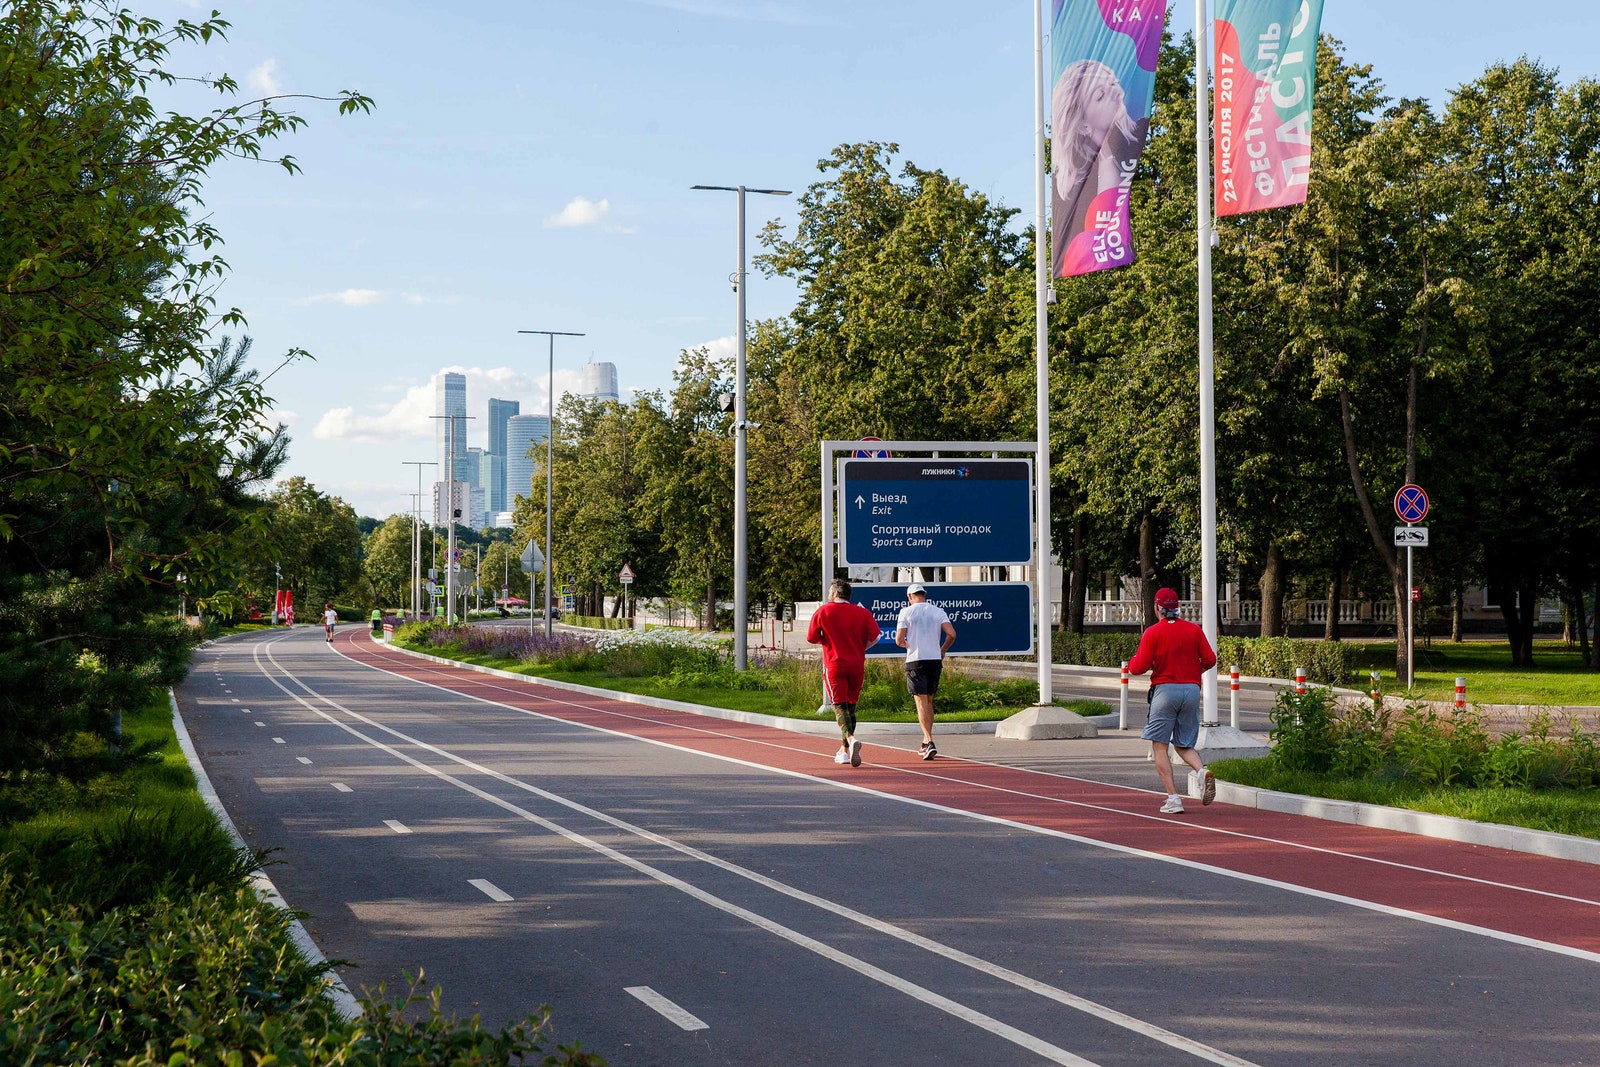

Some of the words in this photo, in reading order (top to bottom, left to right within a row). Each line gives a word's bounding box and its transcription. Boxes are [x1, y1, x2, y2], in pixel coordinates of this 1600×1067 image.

[1221, 53, 1235, 102] 2017
[1245, 22, 1281, 196] ФЕСТИВАЛЬ
[1221, 107, 1232, 174] ИЮЛЯ
[1223, 178, 1237, 203] 22
[872, 493, 908, 505] Выезд
[871, 506, 892, 515] Exit
[871, 524, 941, 537] Спортивный
[945, 525, 992, 535] городок
[872, 538, 903, 548] Sports
[906, 537, 933, 548] Camp
[949, 611, 961, 621] of
[962, 611, 993, 622] Sports
